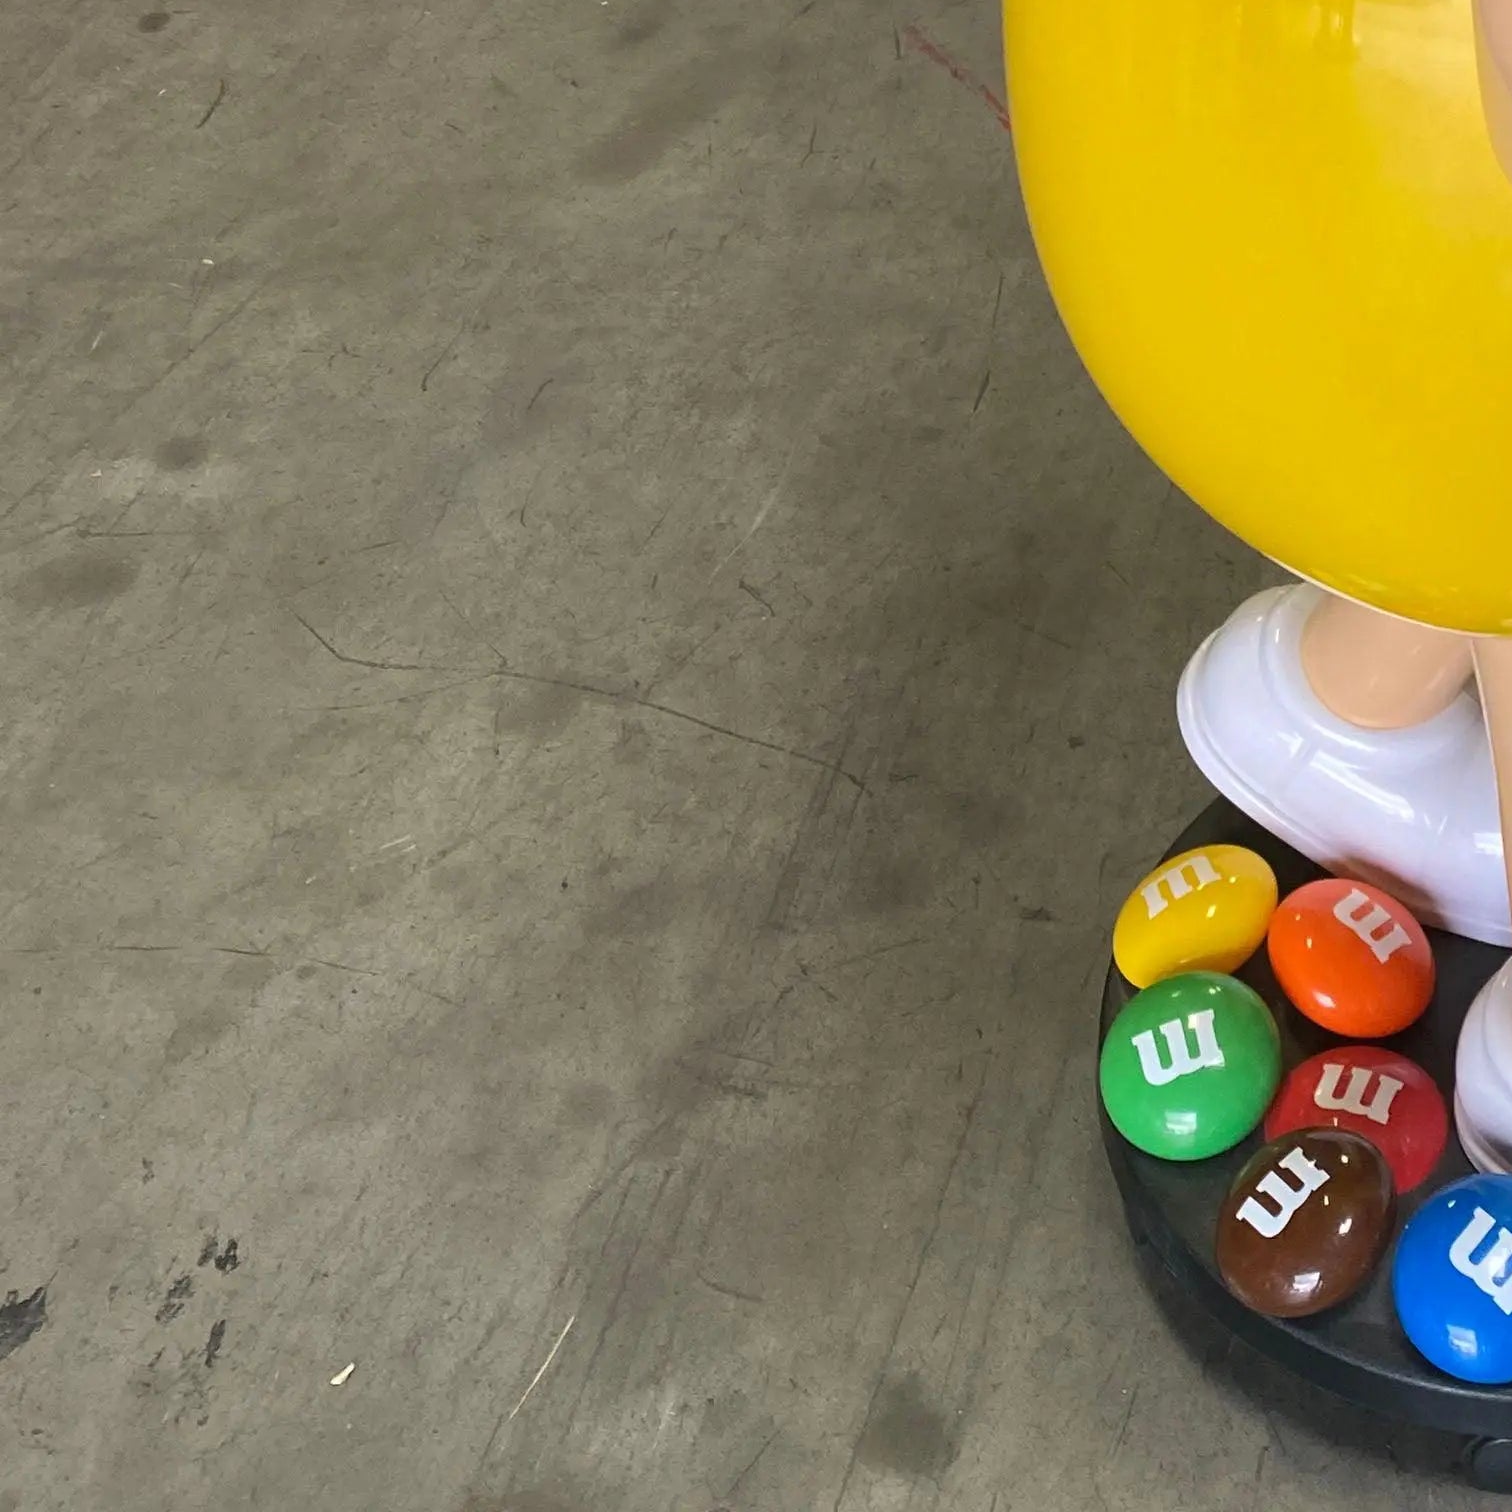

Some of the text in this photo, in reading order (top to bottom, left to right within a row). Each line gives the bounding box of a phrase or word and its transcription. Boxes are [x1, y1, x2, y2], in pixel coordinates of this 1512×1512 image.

[1140, 855, 1221, 919] m
[1332, 888, 1412, 964] m
[1131, 1009, 1225, 1086] m
[1315, 1063, 1404, 1125] m
[1235, 1147, 1331, 1238] m
